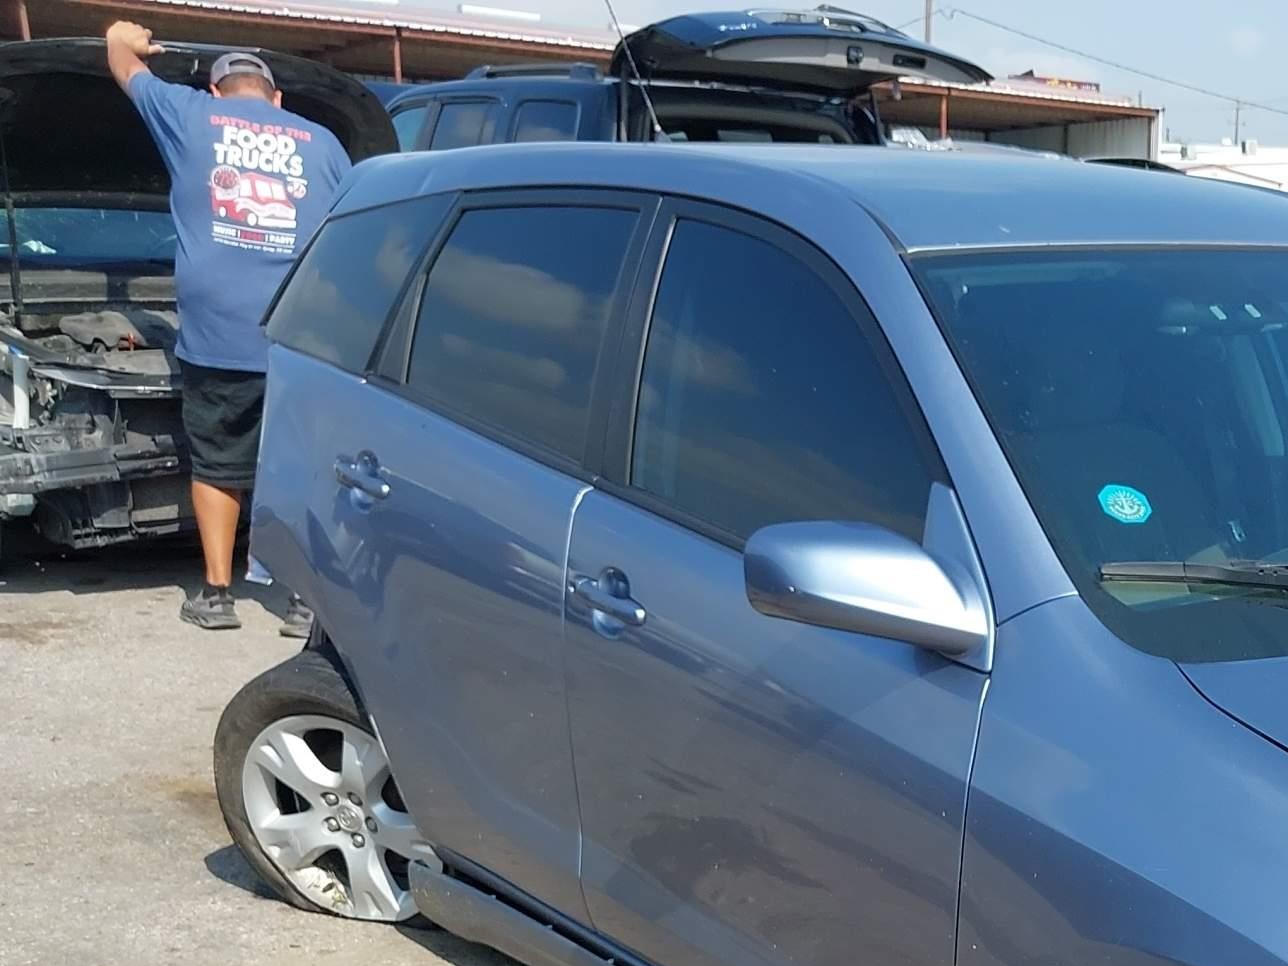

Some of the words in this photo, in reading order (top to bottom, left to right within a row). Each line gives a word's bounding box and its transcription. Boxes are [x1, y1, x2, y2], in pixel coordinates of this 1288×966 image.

[210, 115, 260, 133] BATTLE
[263, 124, 283, 135] OF
[285, 127, 312, 142] THE
[223, 125, 297, 155] FOOD
[213, 142, 304, 177] TRUCKS
